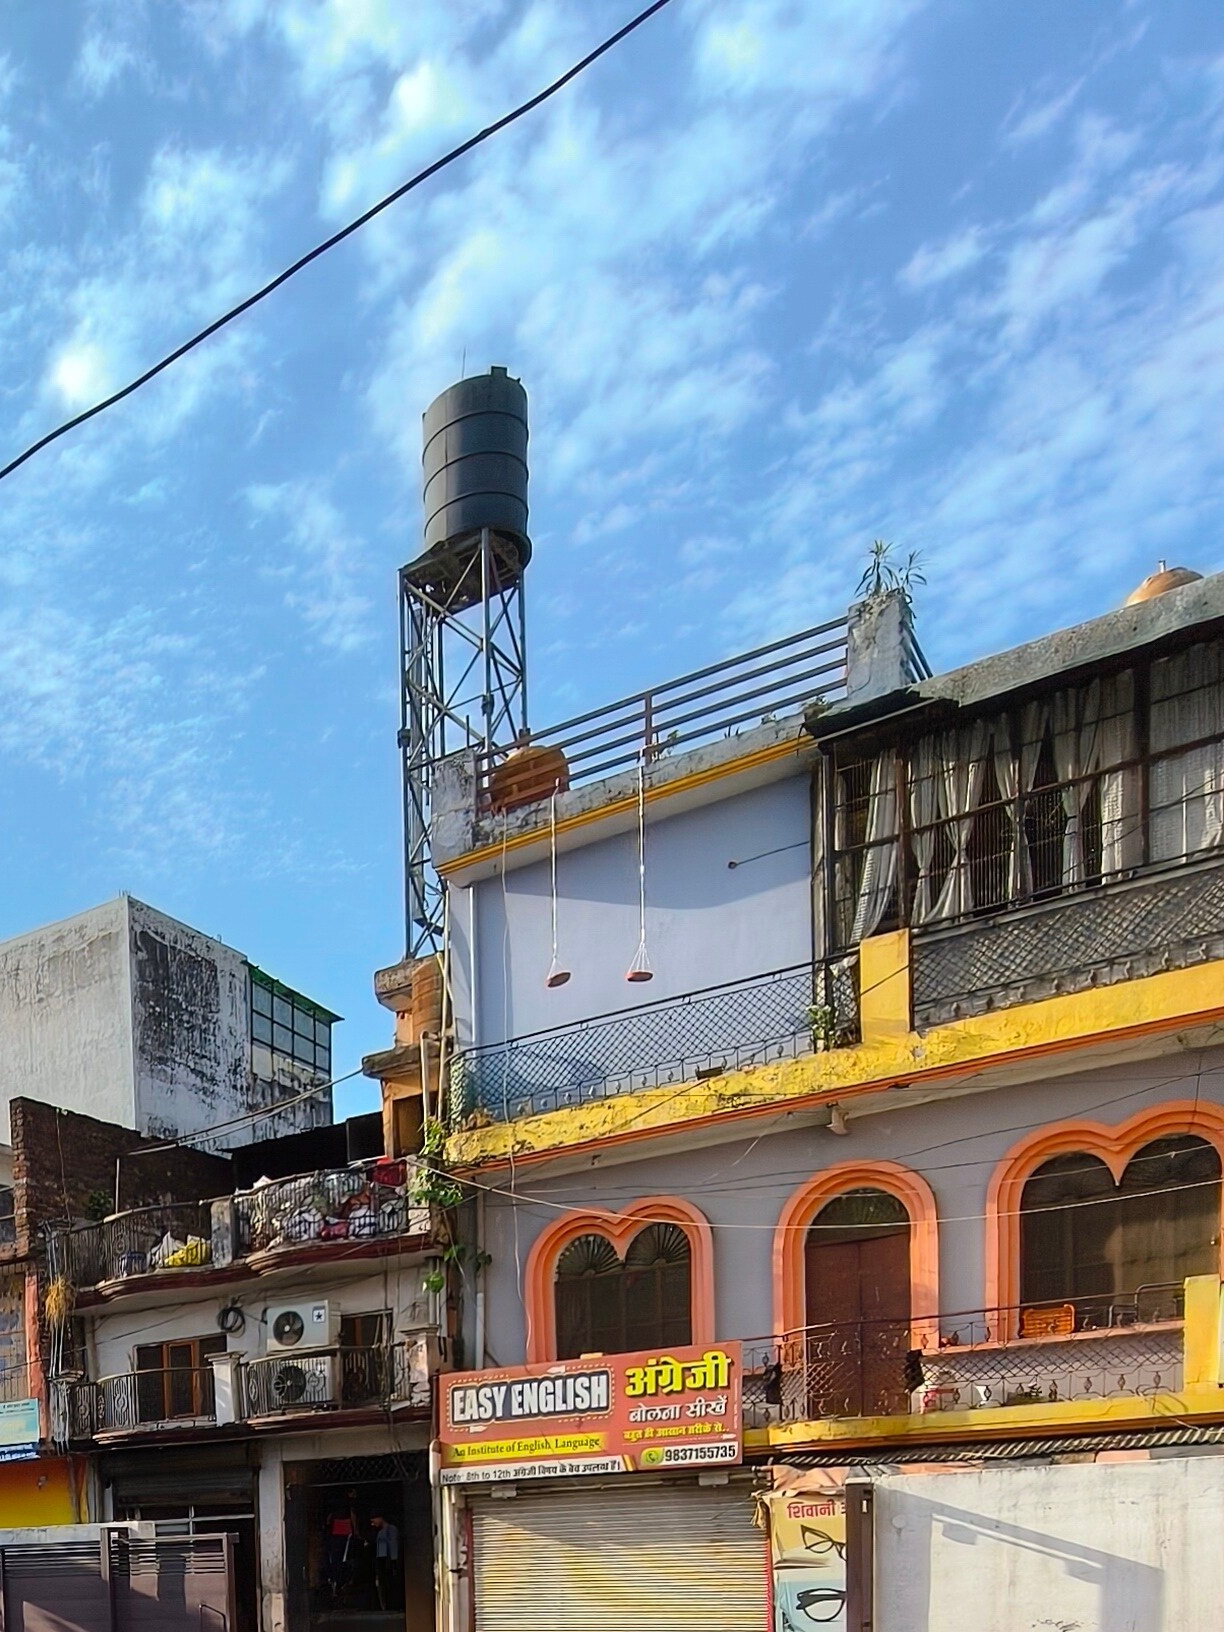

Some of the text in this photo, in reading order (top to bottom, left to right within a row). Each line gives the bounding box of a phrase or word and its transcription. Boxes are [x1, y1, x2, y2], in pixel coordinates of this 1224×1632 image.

[625, 1351, 732, 1396] अंग्रेजी
[453, 1375, 607, 1421] EASY ENGLISH
[629, 1402, 683, 1422] बोलना
[685, 1395, 728, 1418] सीखें
[453, 1435, 601, 1458] An Institute of English Language
[665, 1444, 736, 1462] 9837155735
[466, 1471, 479, 1481] 8th
[482, 1470, 490, 1480] to
[493, 1468, 511, 1479] 12th
[787, 1500, 836, 1519] शिवानी
